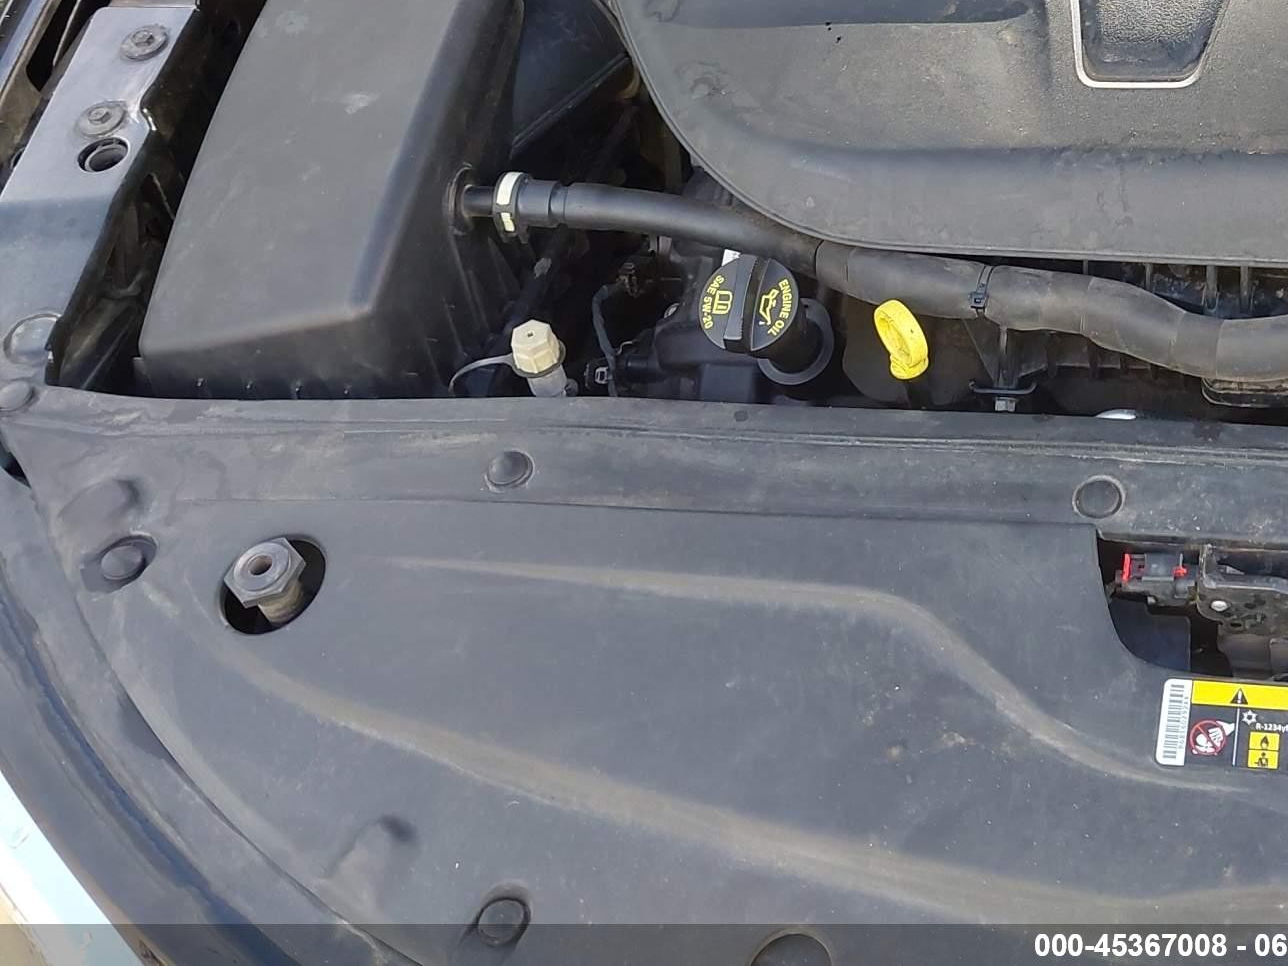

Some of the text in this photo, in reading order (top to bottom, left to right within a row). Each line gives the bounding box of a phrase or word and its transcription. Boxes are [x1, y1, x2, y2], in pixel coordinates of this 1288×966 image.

[701, 275, 725, 330] SAE 5W-20
[767, 278, 793, 336] ENGINE OIL
